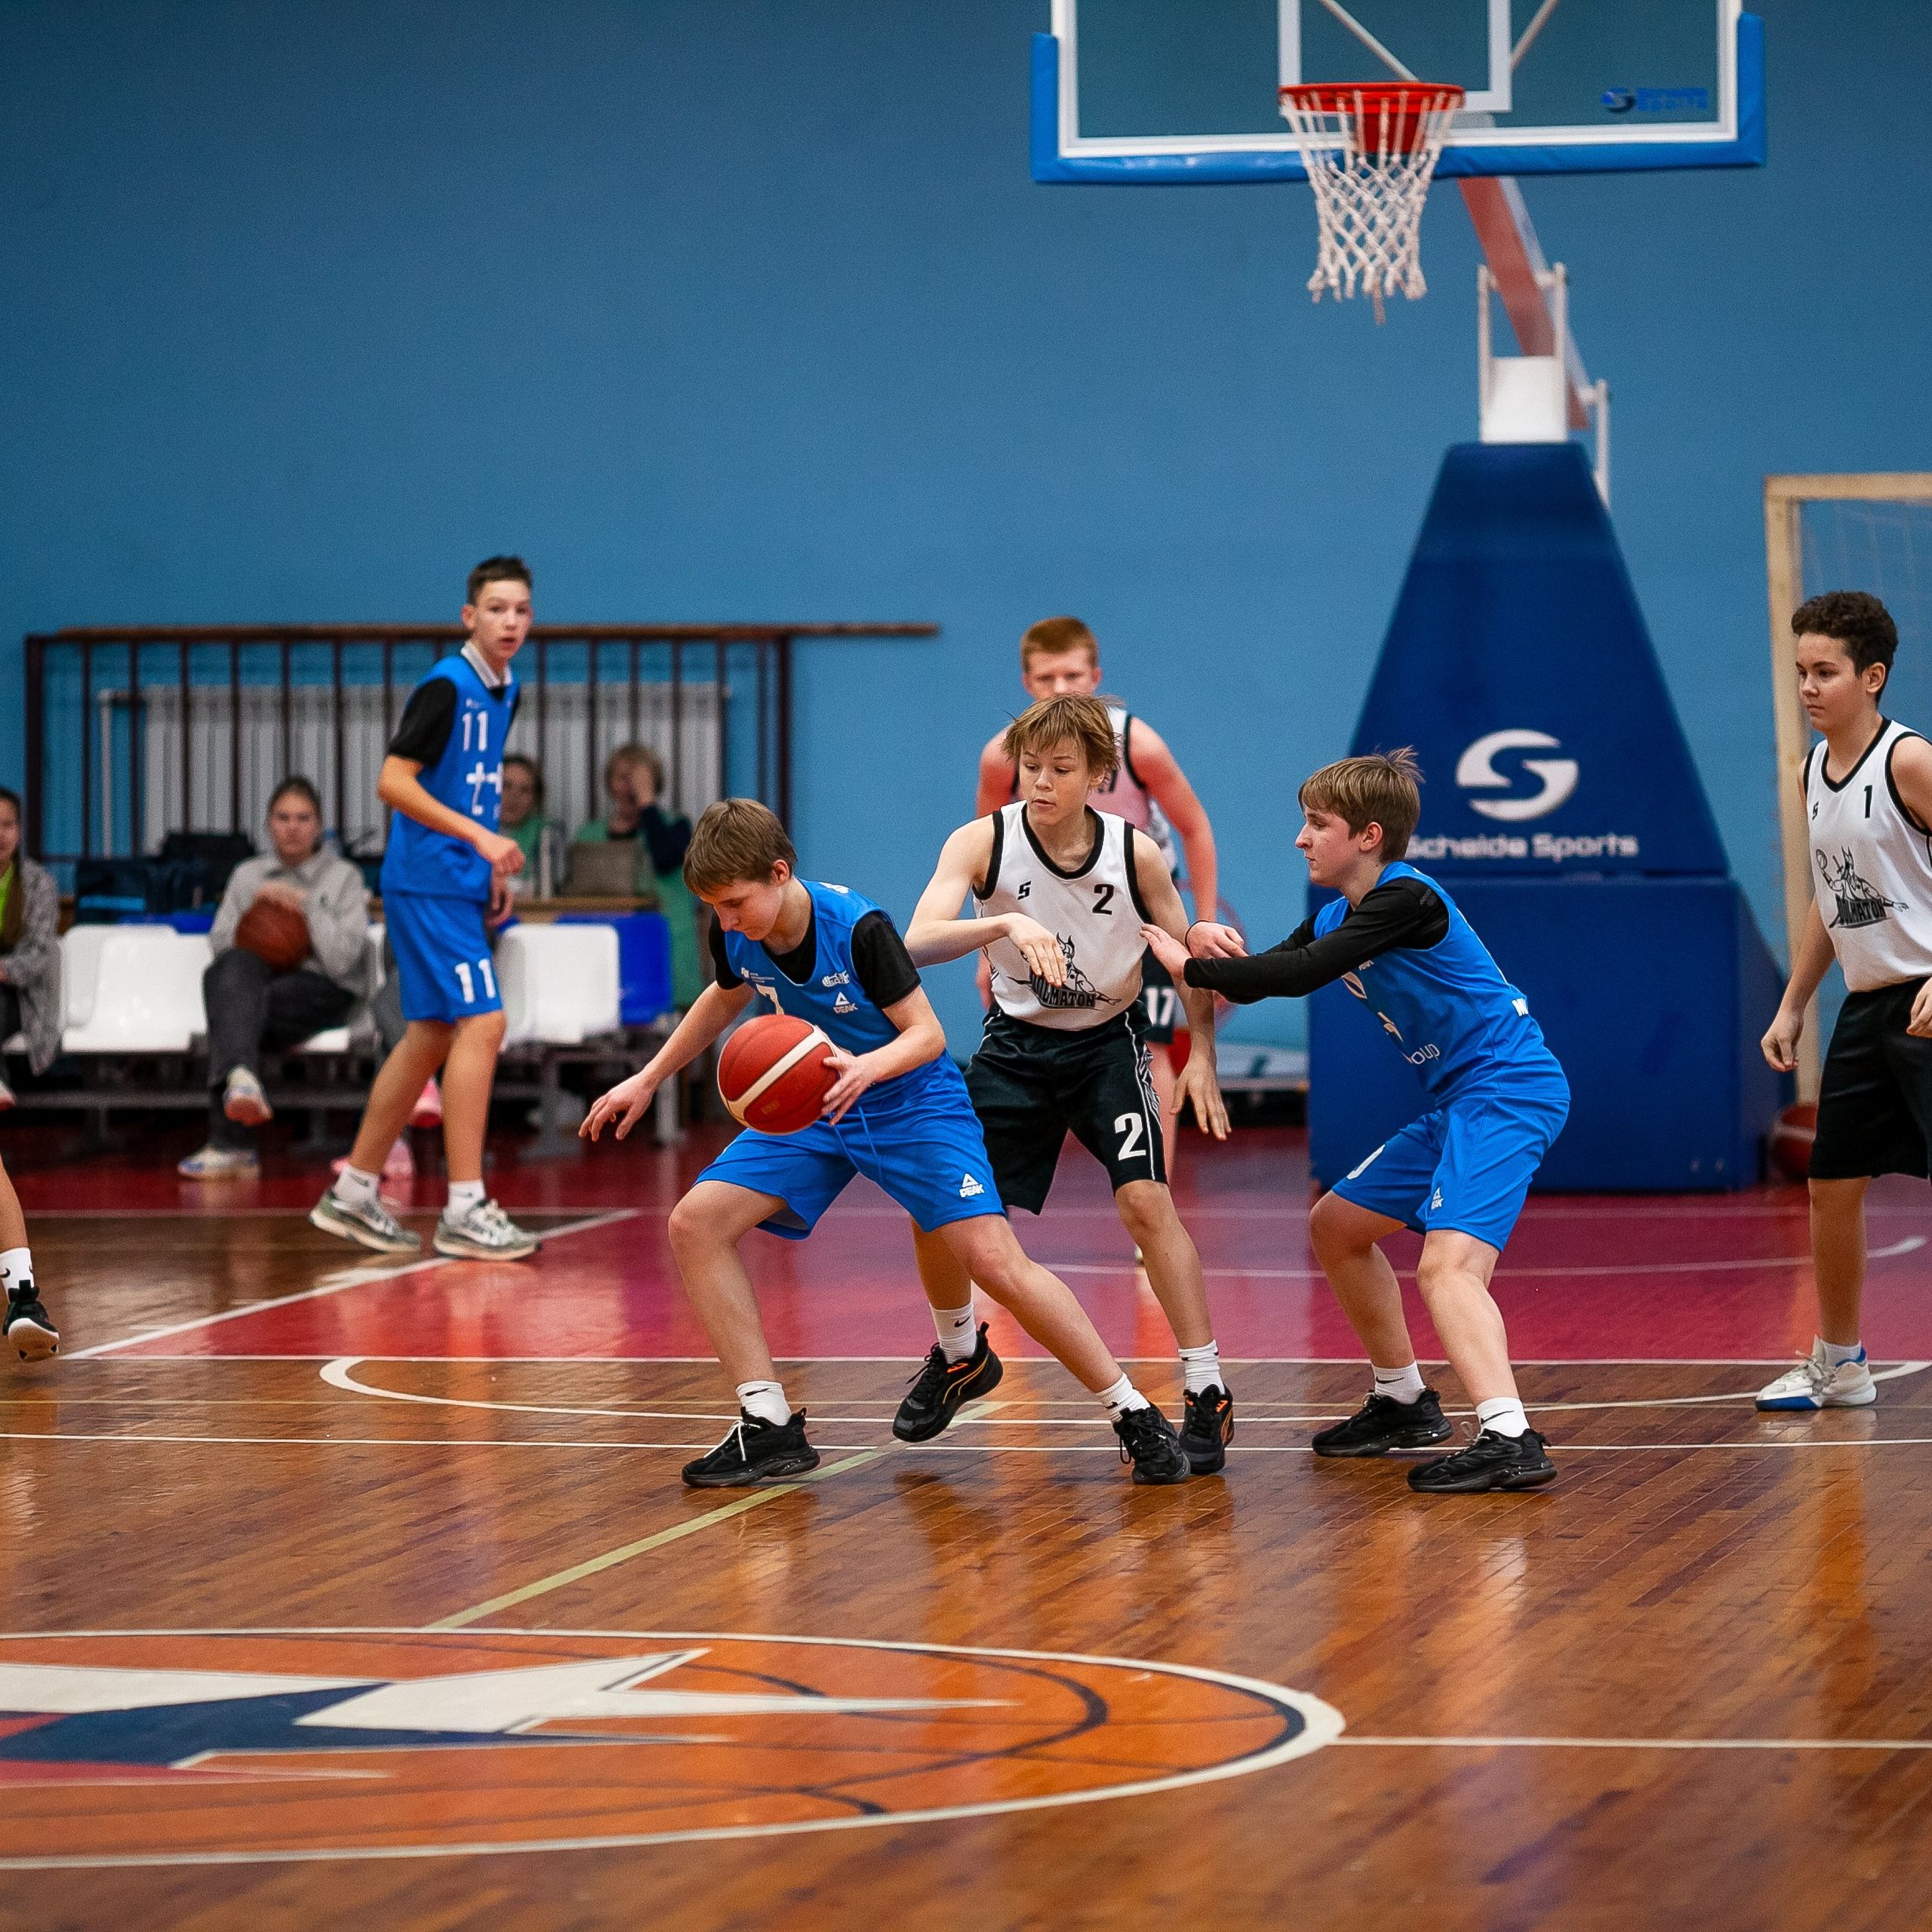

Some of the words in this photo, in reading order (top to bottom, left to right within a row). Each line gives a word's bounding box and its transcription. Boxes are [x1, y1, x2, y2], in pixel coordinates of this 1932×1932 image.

[462, 710, 488, 752] 11
[1863, 784, 1872, 819] 1
[1531, 832, 1638, 862] Sports
[1092, 883, 1115, 915] 2
[454, 958, 496, 1004] 11
[832, 1002, 859, 1014] PEAK
[1144, 983, 1175, 1027] 17
[1114, 1112, 1146, 1161] 2
[959, 1184, 985, 1198] PEAK
